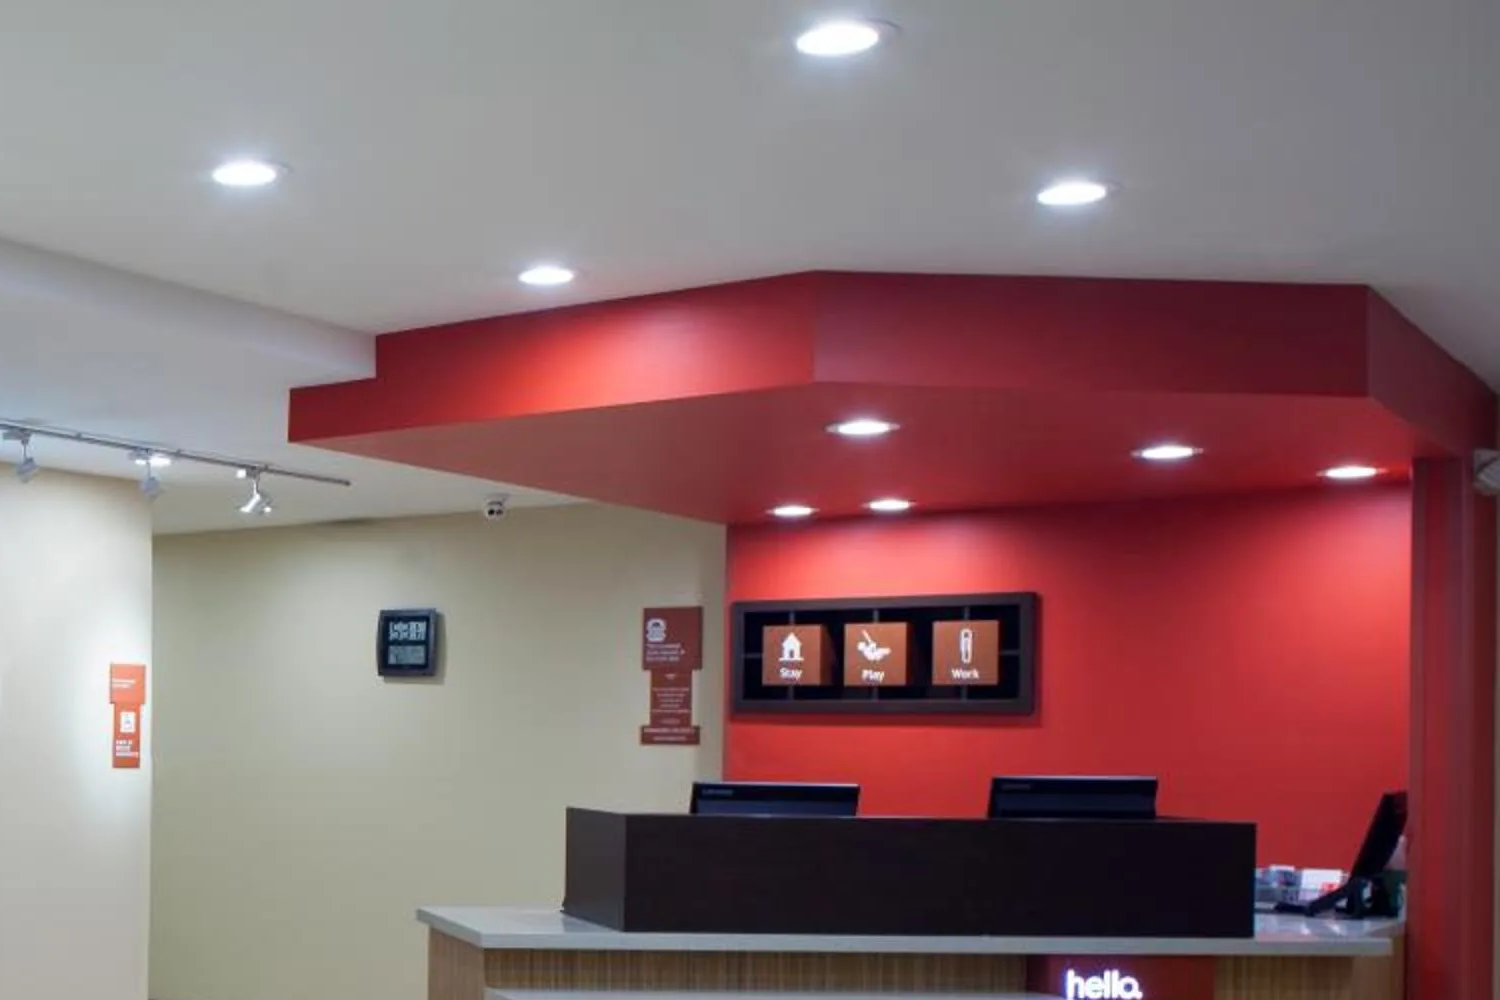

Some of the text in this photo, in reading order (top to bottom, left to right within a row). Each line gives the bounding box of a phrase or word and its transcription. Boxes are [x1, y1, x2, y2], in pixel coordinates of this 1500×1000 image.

[780, 667, 803, 681] Stay
[862, 669, 884, 682] Play
[952, 668, 979, 680] Work
[1066, 968, 1144, 1000] hello.
